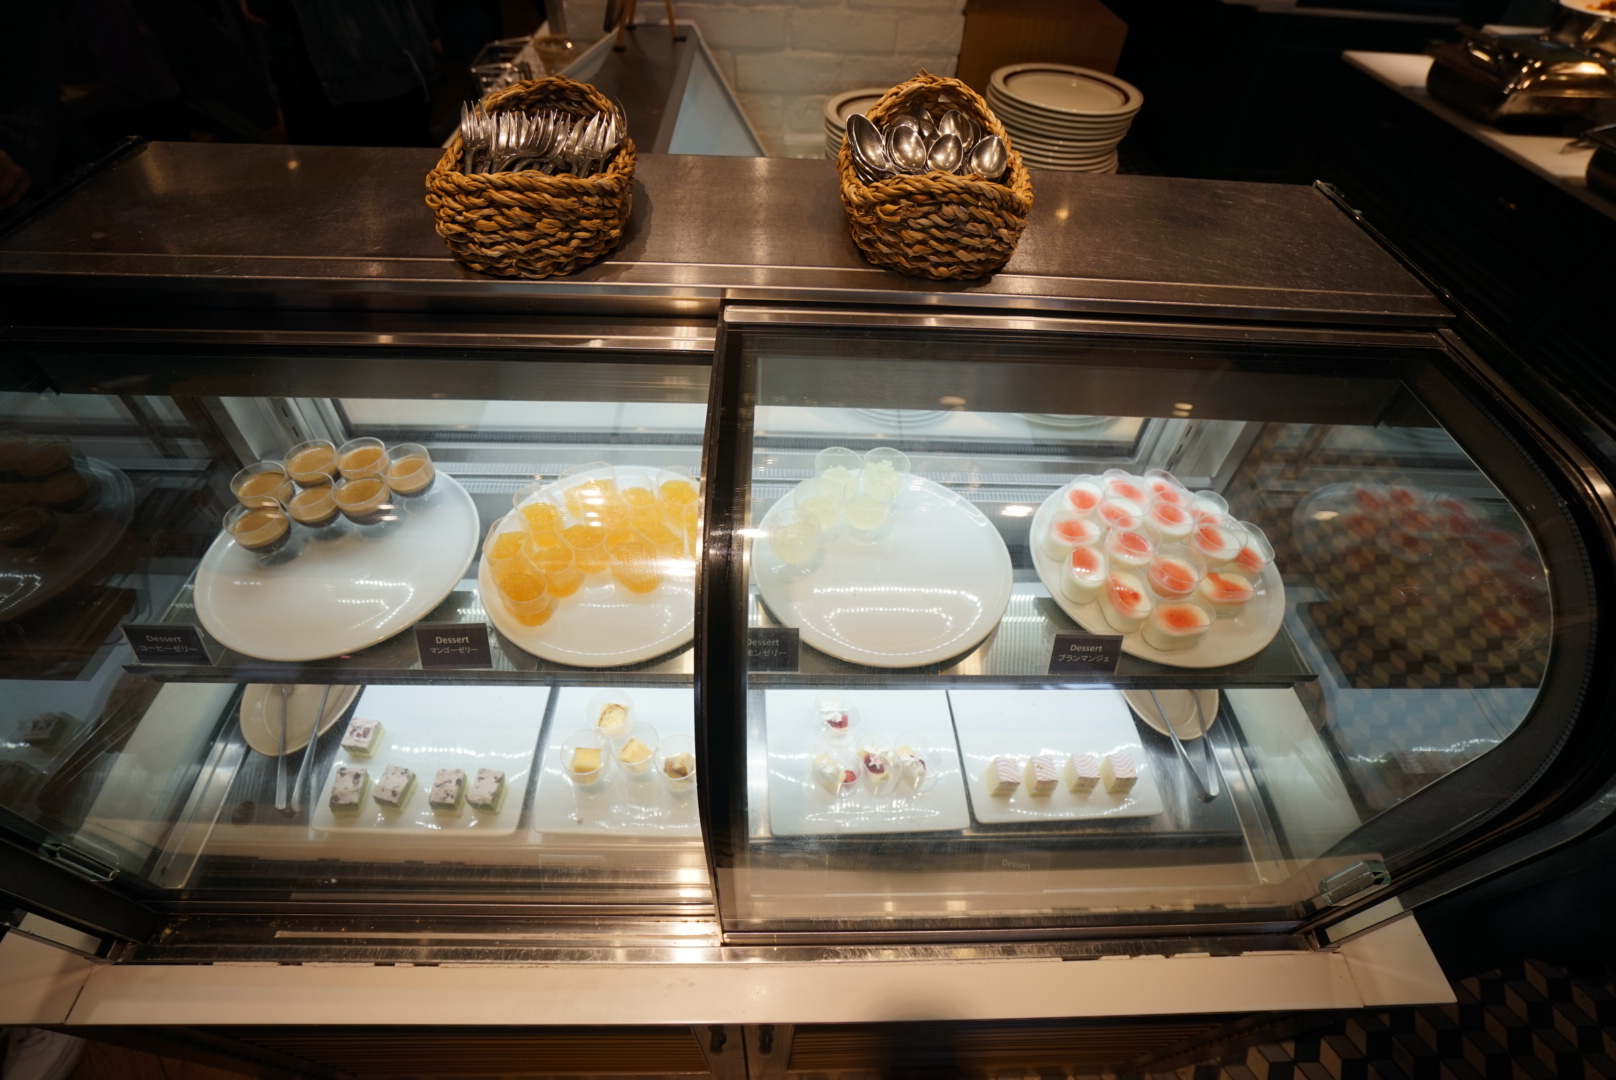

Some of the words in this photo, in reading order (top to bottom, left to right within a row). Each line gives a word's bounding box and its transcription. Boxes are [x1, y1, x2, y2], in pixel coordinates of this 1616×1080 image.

[146, 635, 182, 643] Dessert
[435, 636, 470, 644] Dessert
[430, 646, 478, 654] マンゴーゼリー
[1070, 644, 1103, 652] Dessert
[747, 649, 787, 657] モンゼリー
[1058, 653, 1110, 662] ブランマンジェ
[1001, 859, 1031, 870] Dessert
